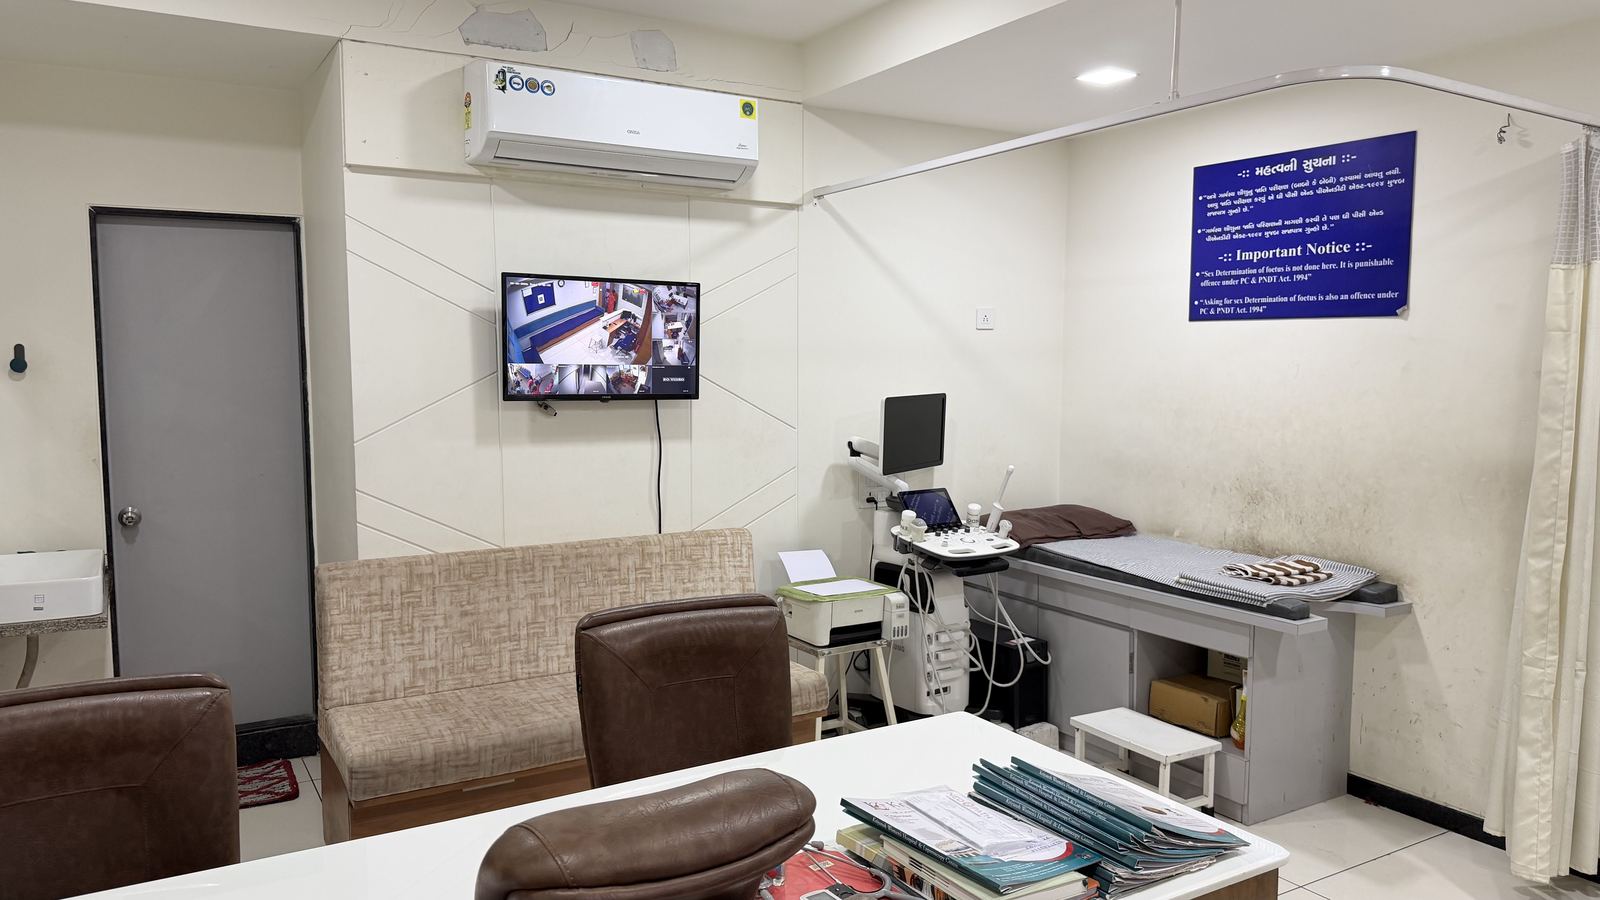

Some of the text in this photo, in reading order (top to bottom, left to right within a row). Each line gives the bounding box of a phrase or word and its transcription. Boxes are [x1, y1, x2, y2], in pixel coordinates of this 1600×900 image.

[1255, 157, 1297, 176] મહત્વની
[1302, 155, 1336, 173] સુચના
[1236, 245, 1302, 262] Important
[1306, 241, 1350, 255] Notice
[1215, 267, 1257, 276] Determination
[1265, 265, 1284, 273] foetus
[1285, 264, 1291, 272] is
[1340, 260, 1346, 268] It
[1347, 260, 1353, 268] is
[1354, 258, 1394, 269] punishable
[1240, 276, 1249, 284] PC
[1250, 276, 1256, 284] &
[1258, 275, 1278, 283] PNDT
[1244, 295, 1288, 303] Determination
[1289, 294, 1297, 302] of
[1350, 291, 1375, 299] offence
[1377, 290, 1399, 298] under
[1216, 306, 1235, 314] PNDT
